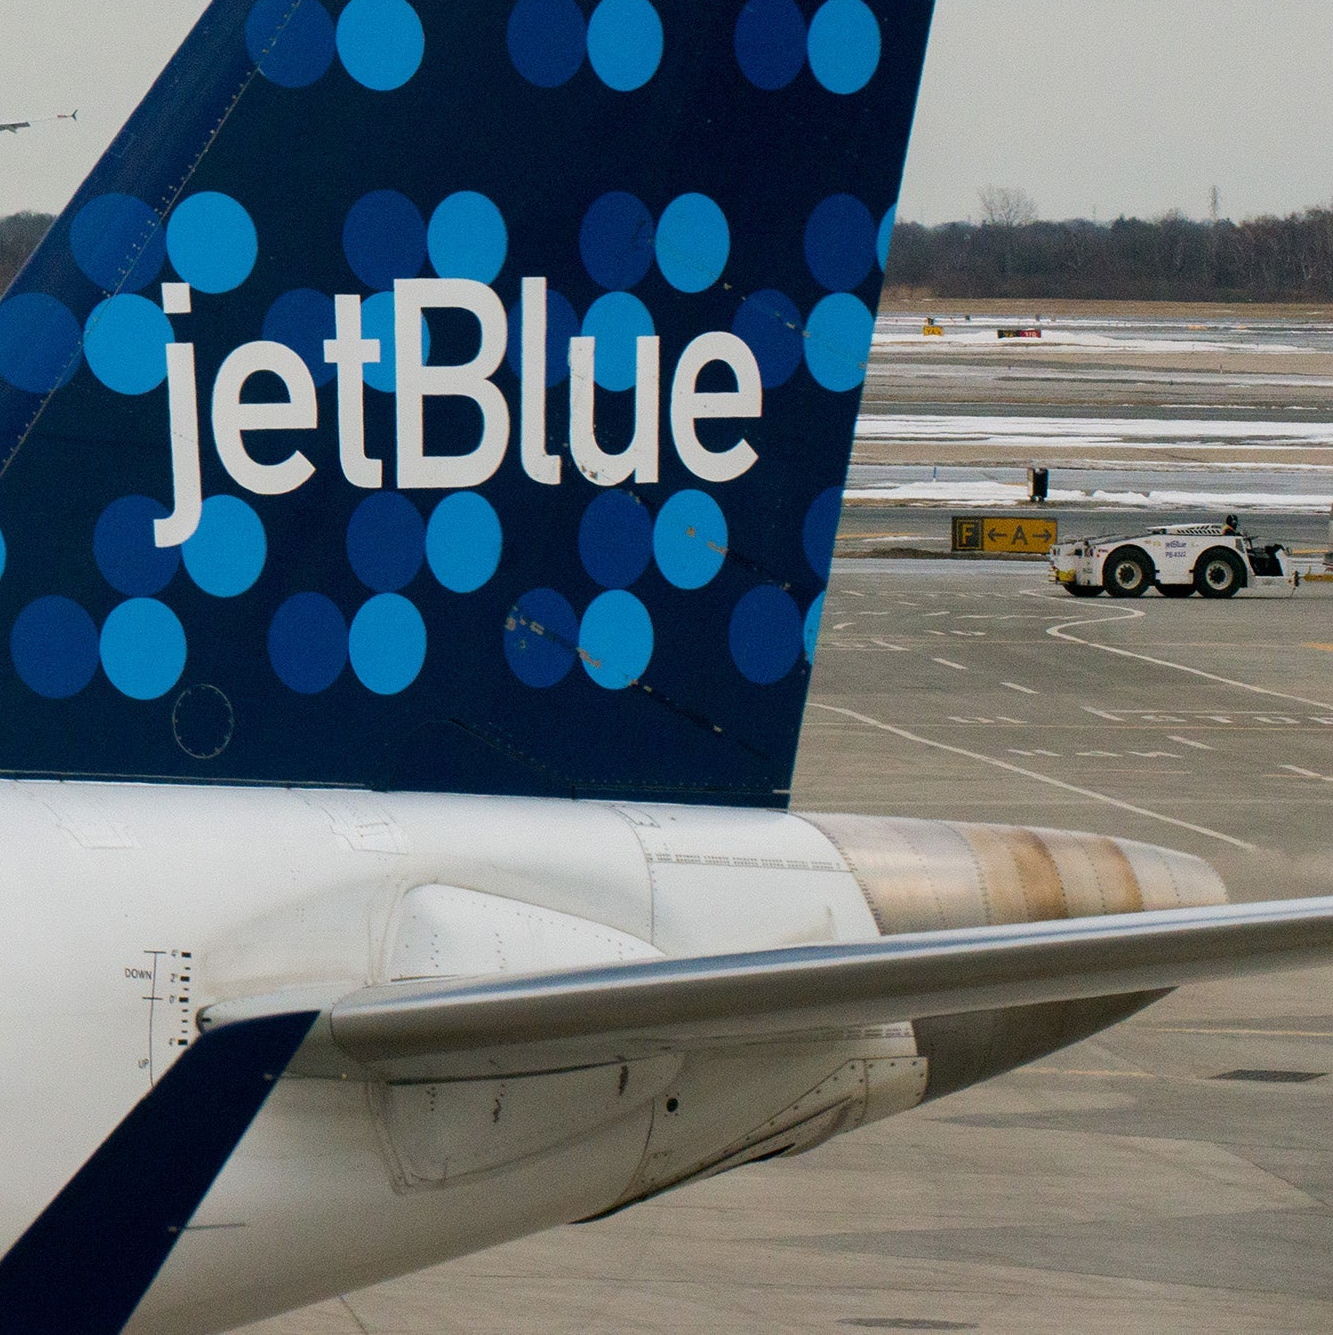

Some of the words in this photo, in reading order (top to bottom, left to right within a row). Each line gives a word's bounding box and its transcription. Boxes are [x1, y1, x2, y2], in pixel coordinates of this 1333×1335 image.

[154, 277, 763, 548] jetBlue
[961, 524, 975, 545] F
[1011, 524, 1029, 545] A
[124, 968, 152, 980] DOWN
[137, 1057, 150, 1069] UP
